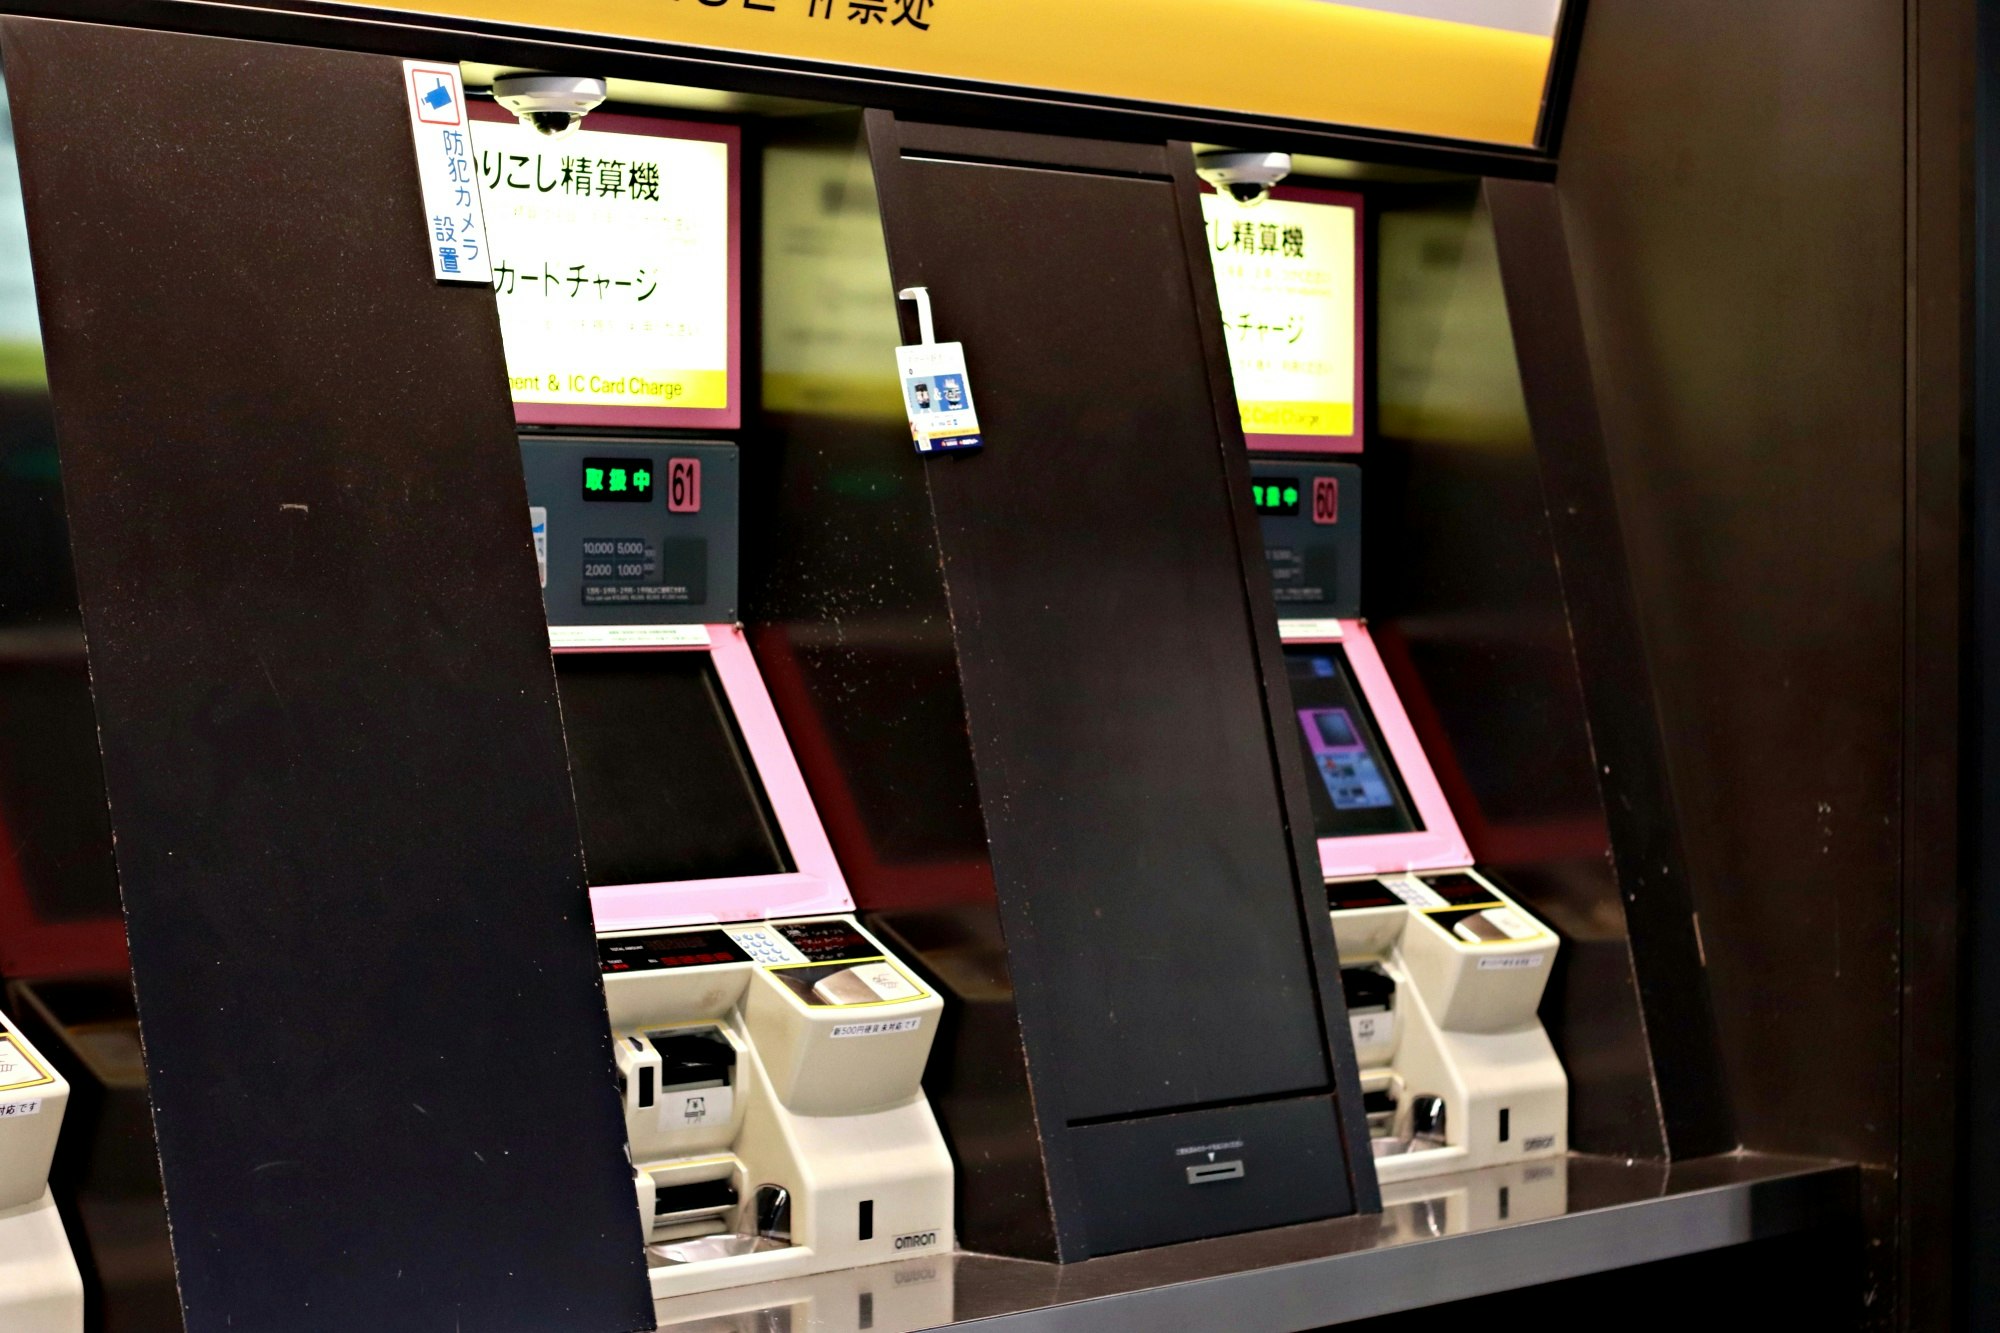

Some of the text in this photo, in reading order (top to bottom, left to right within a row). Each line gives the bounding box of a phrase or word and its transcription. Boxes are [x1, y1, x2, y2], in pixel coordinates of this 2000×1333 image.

[474, 150, 660, 201] りこし精算機
[443, 130, 478, 260] 防犯カメラ
[433, 215, 461, 273] 設置
[1204, 219, 1304, 258] し精算機
[548, 374, 560, 391] &
[569, 376, 585, 392] IC
[590, 376, 625, 394] Card
[629, 377, 683, 400] Charge
[673, 463, 694, 507] 61
[1316, 482, 1334, 519] 60
[584, 542, 615, 555] 10,000
[617, 542, 643, 555] 5,000
[585, 563, 612, 577] 2,000
[618, 563, 642, 577] 1,000
[895, 1232, 936, 1250] OMRON
